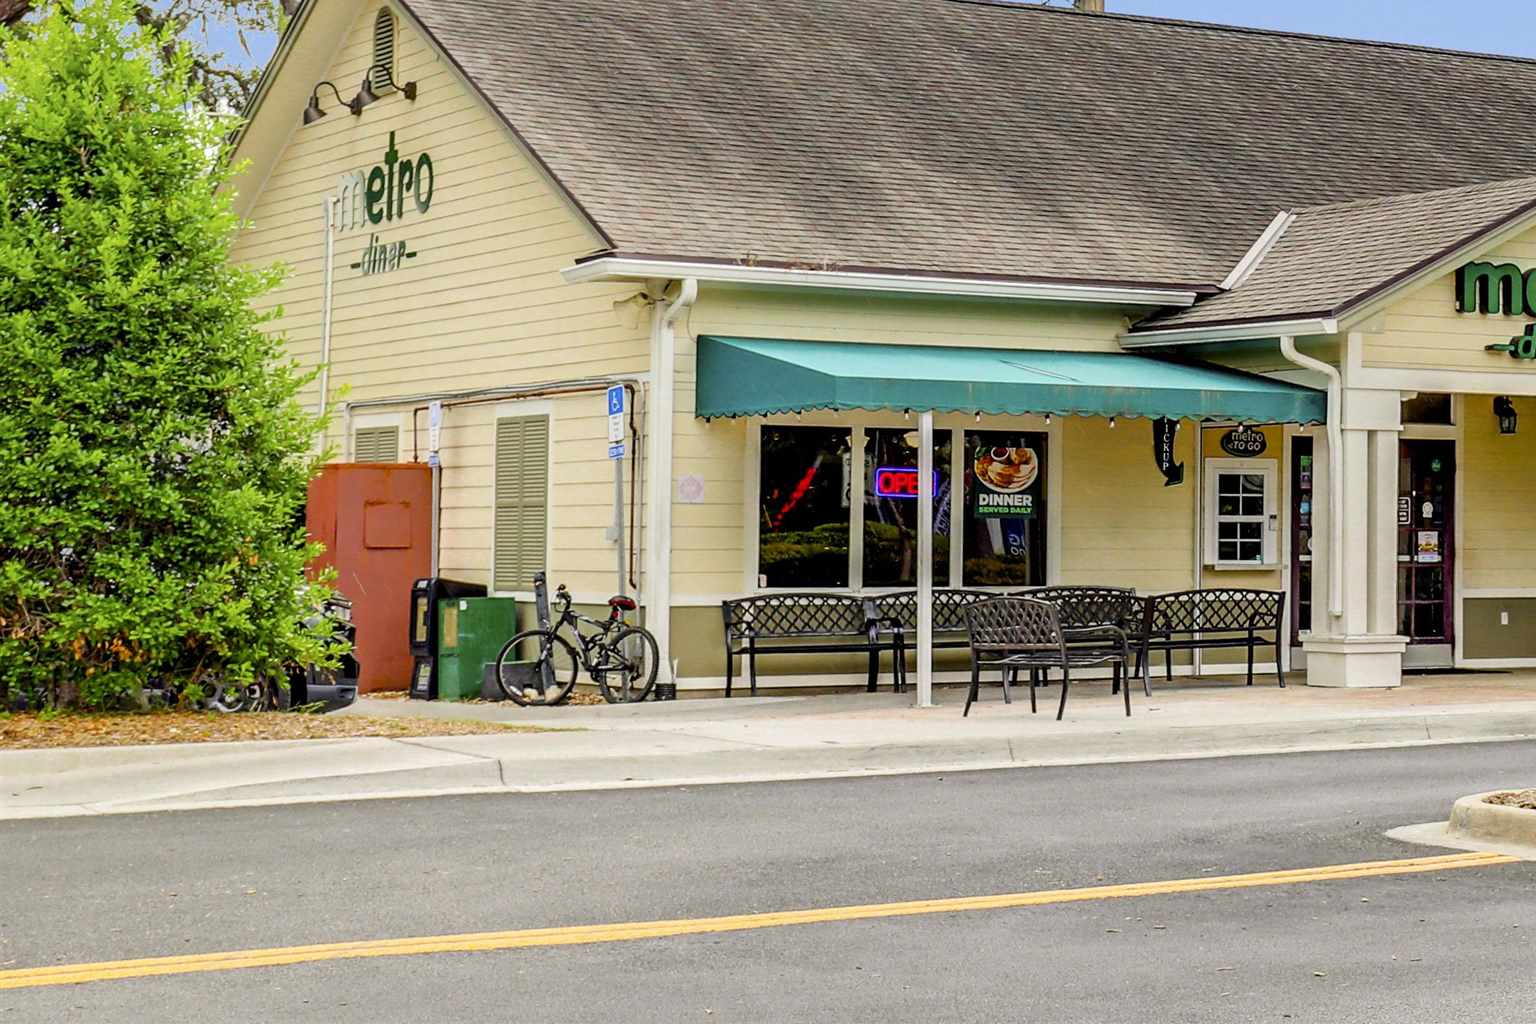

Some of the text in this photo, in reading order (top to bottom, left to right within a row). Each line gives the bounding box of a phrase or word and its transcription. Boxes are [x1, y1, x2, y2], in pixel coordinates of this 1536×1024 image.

[335, 131, 434, 232] metro
[1231, 428, 1264, 442] metro
[1234, 440, 1261, 451] TO GO
[879, 472, 921, 494] OPE
[979, 494, 1032, 506] DINNER
